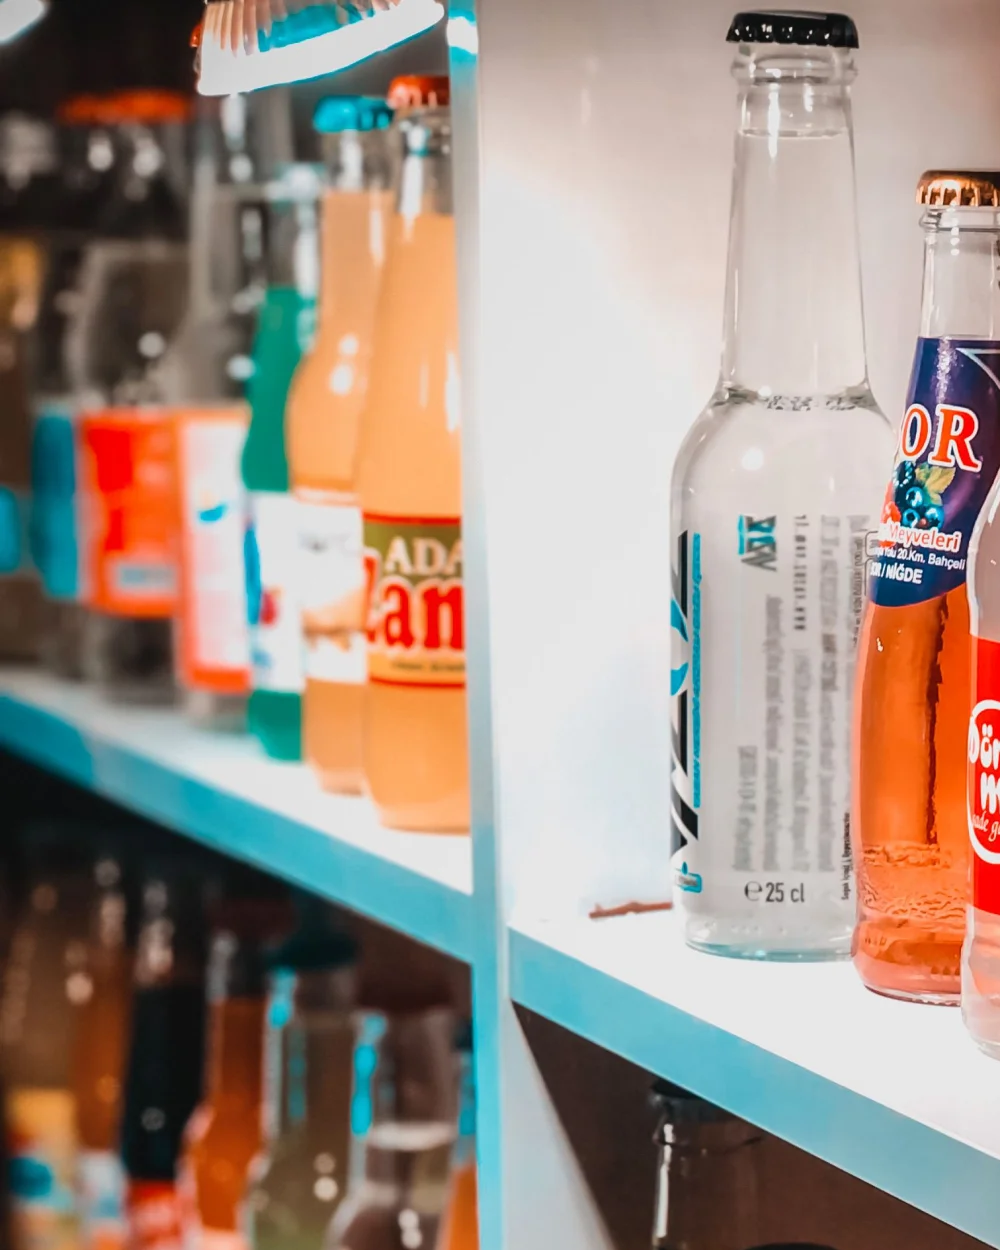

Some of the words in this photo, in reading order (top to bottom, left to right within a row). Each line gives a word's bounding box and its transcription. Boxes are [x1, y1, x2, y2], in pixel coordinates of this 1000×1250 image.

[887, 522, 962, 553] Meyveleri
[384, 536, 463, 576] ADA
[928, 552, 966, 571] Bahçeli
[886, 562, 924, 585] NİĞDE
